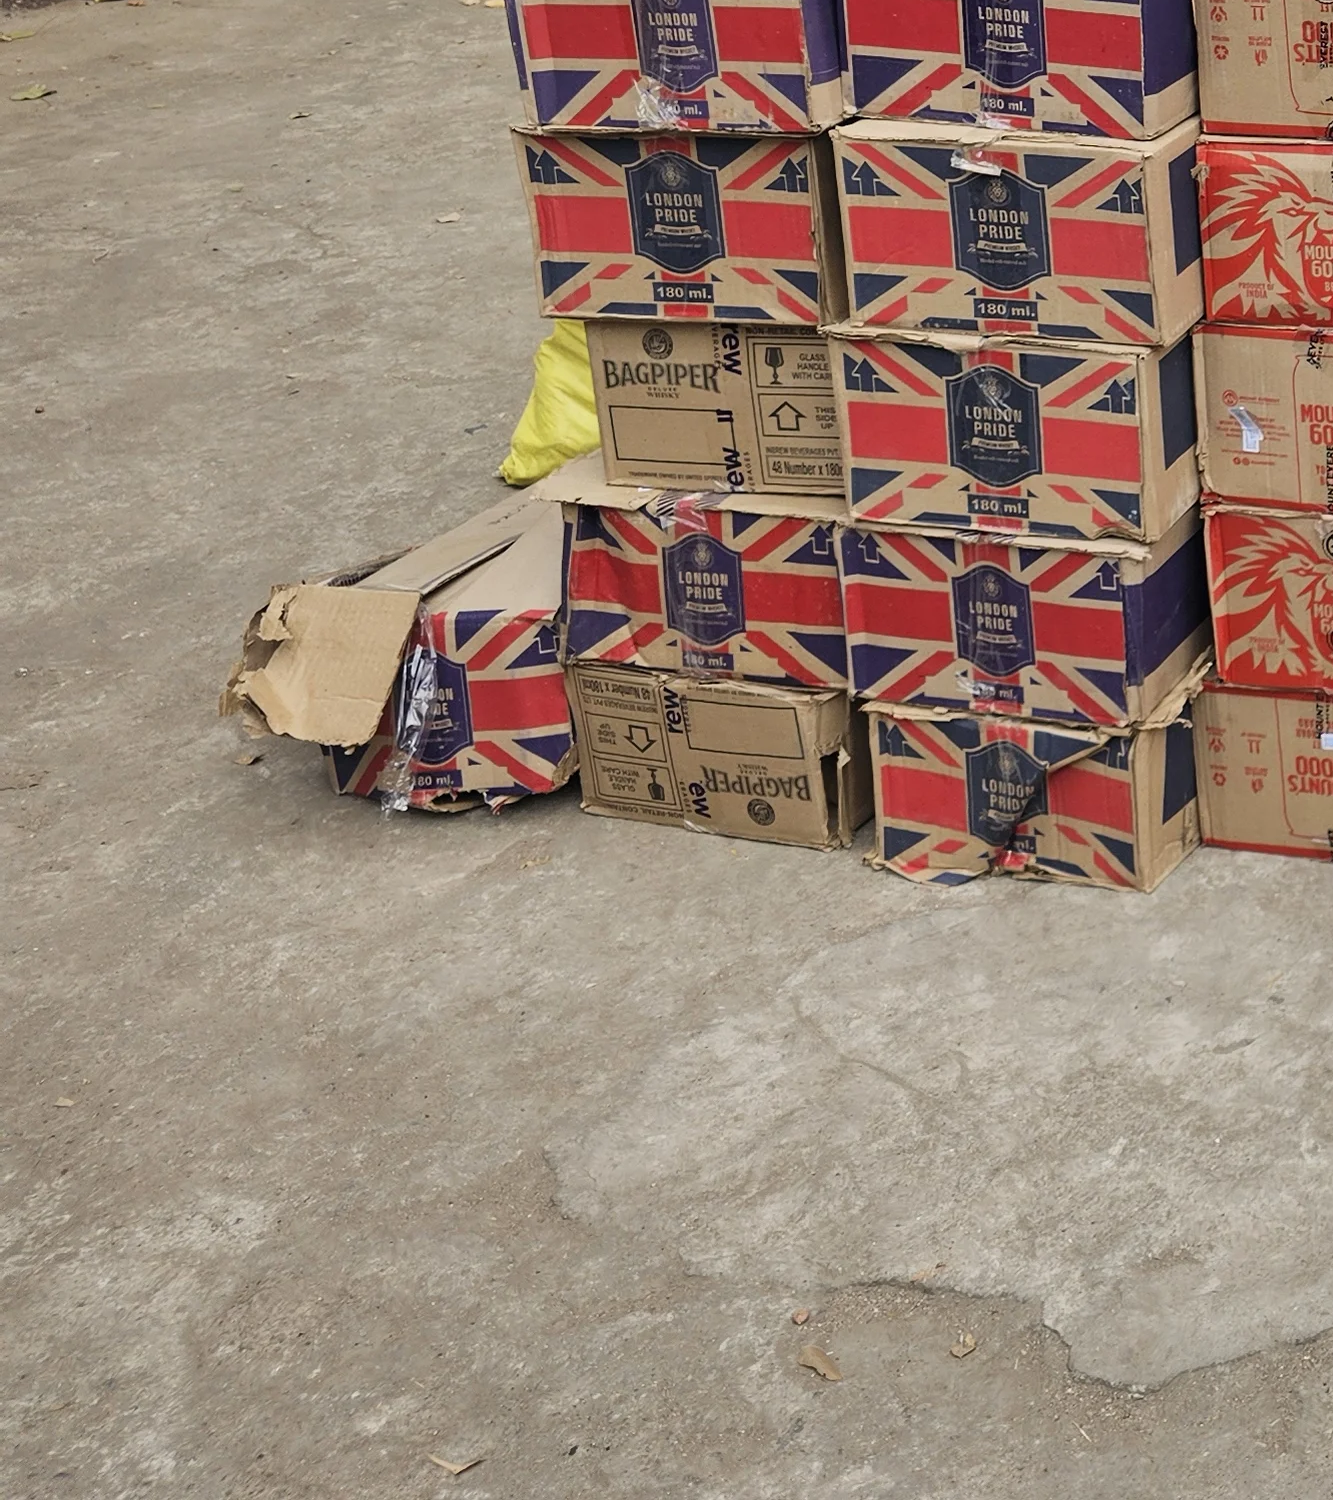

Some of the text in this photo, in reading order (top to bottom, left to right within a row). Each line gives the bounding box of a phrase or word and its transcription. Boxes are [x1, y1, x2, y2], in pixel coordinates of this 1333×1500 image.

[648, 12, 698, 26] LONDON
[978, 6, 1030, 24] LONDON
[657, 28, 694, 42] PRIDE
[986, 22, 1024, 39] PRIDE
[684, 104, 702, 115] ml.
[982, 99, 1027, 112] 180 ml.
[645, 192, 703, 208] LONDON
[655, 208, 697, 223] PRIDE
[969, 208, 1029, 225] LONDON
[979, 224, 1022, 240] PRIDE
[657, 286, 712, 299] 180 ml.
[1246, 290, 1268, 299] INDIA
[978, 303, 1036, 317] 180 ml.
[799, 353, 825, 362] GLASS
[797, 362, 829, 371] HANDLE
[602, 359, 720, 393] BAGPIPER
[792, 372, 812, 380] WITH
[646, 391, 680, 399] WHISKY
[815, 414, 837, 422] SIDE
[965, 405, 1022, 423] LONDON
[974, 421, 1016, 438] PRIDE
[772, 462, 783, 473] 48
[784, 461, 816, 475] Number
[971, 499, 1027, 515] 180 ml.
[678, 571, 729, 587] LONDON
[685, 586, 723, 600] PRIDE
[969, 601, 1018, 618] LONDON
[977, 615, 1013, 631] PRIDE
[708, 657, 727, 666] ml.
[999, 689, 1017, 699] ml.
[436, 773, 455, 786] ml.
[700, 765, 812, 802] BAGPIPER
[981, 778, 1035, 798] LONDON
